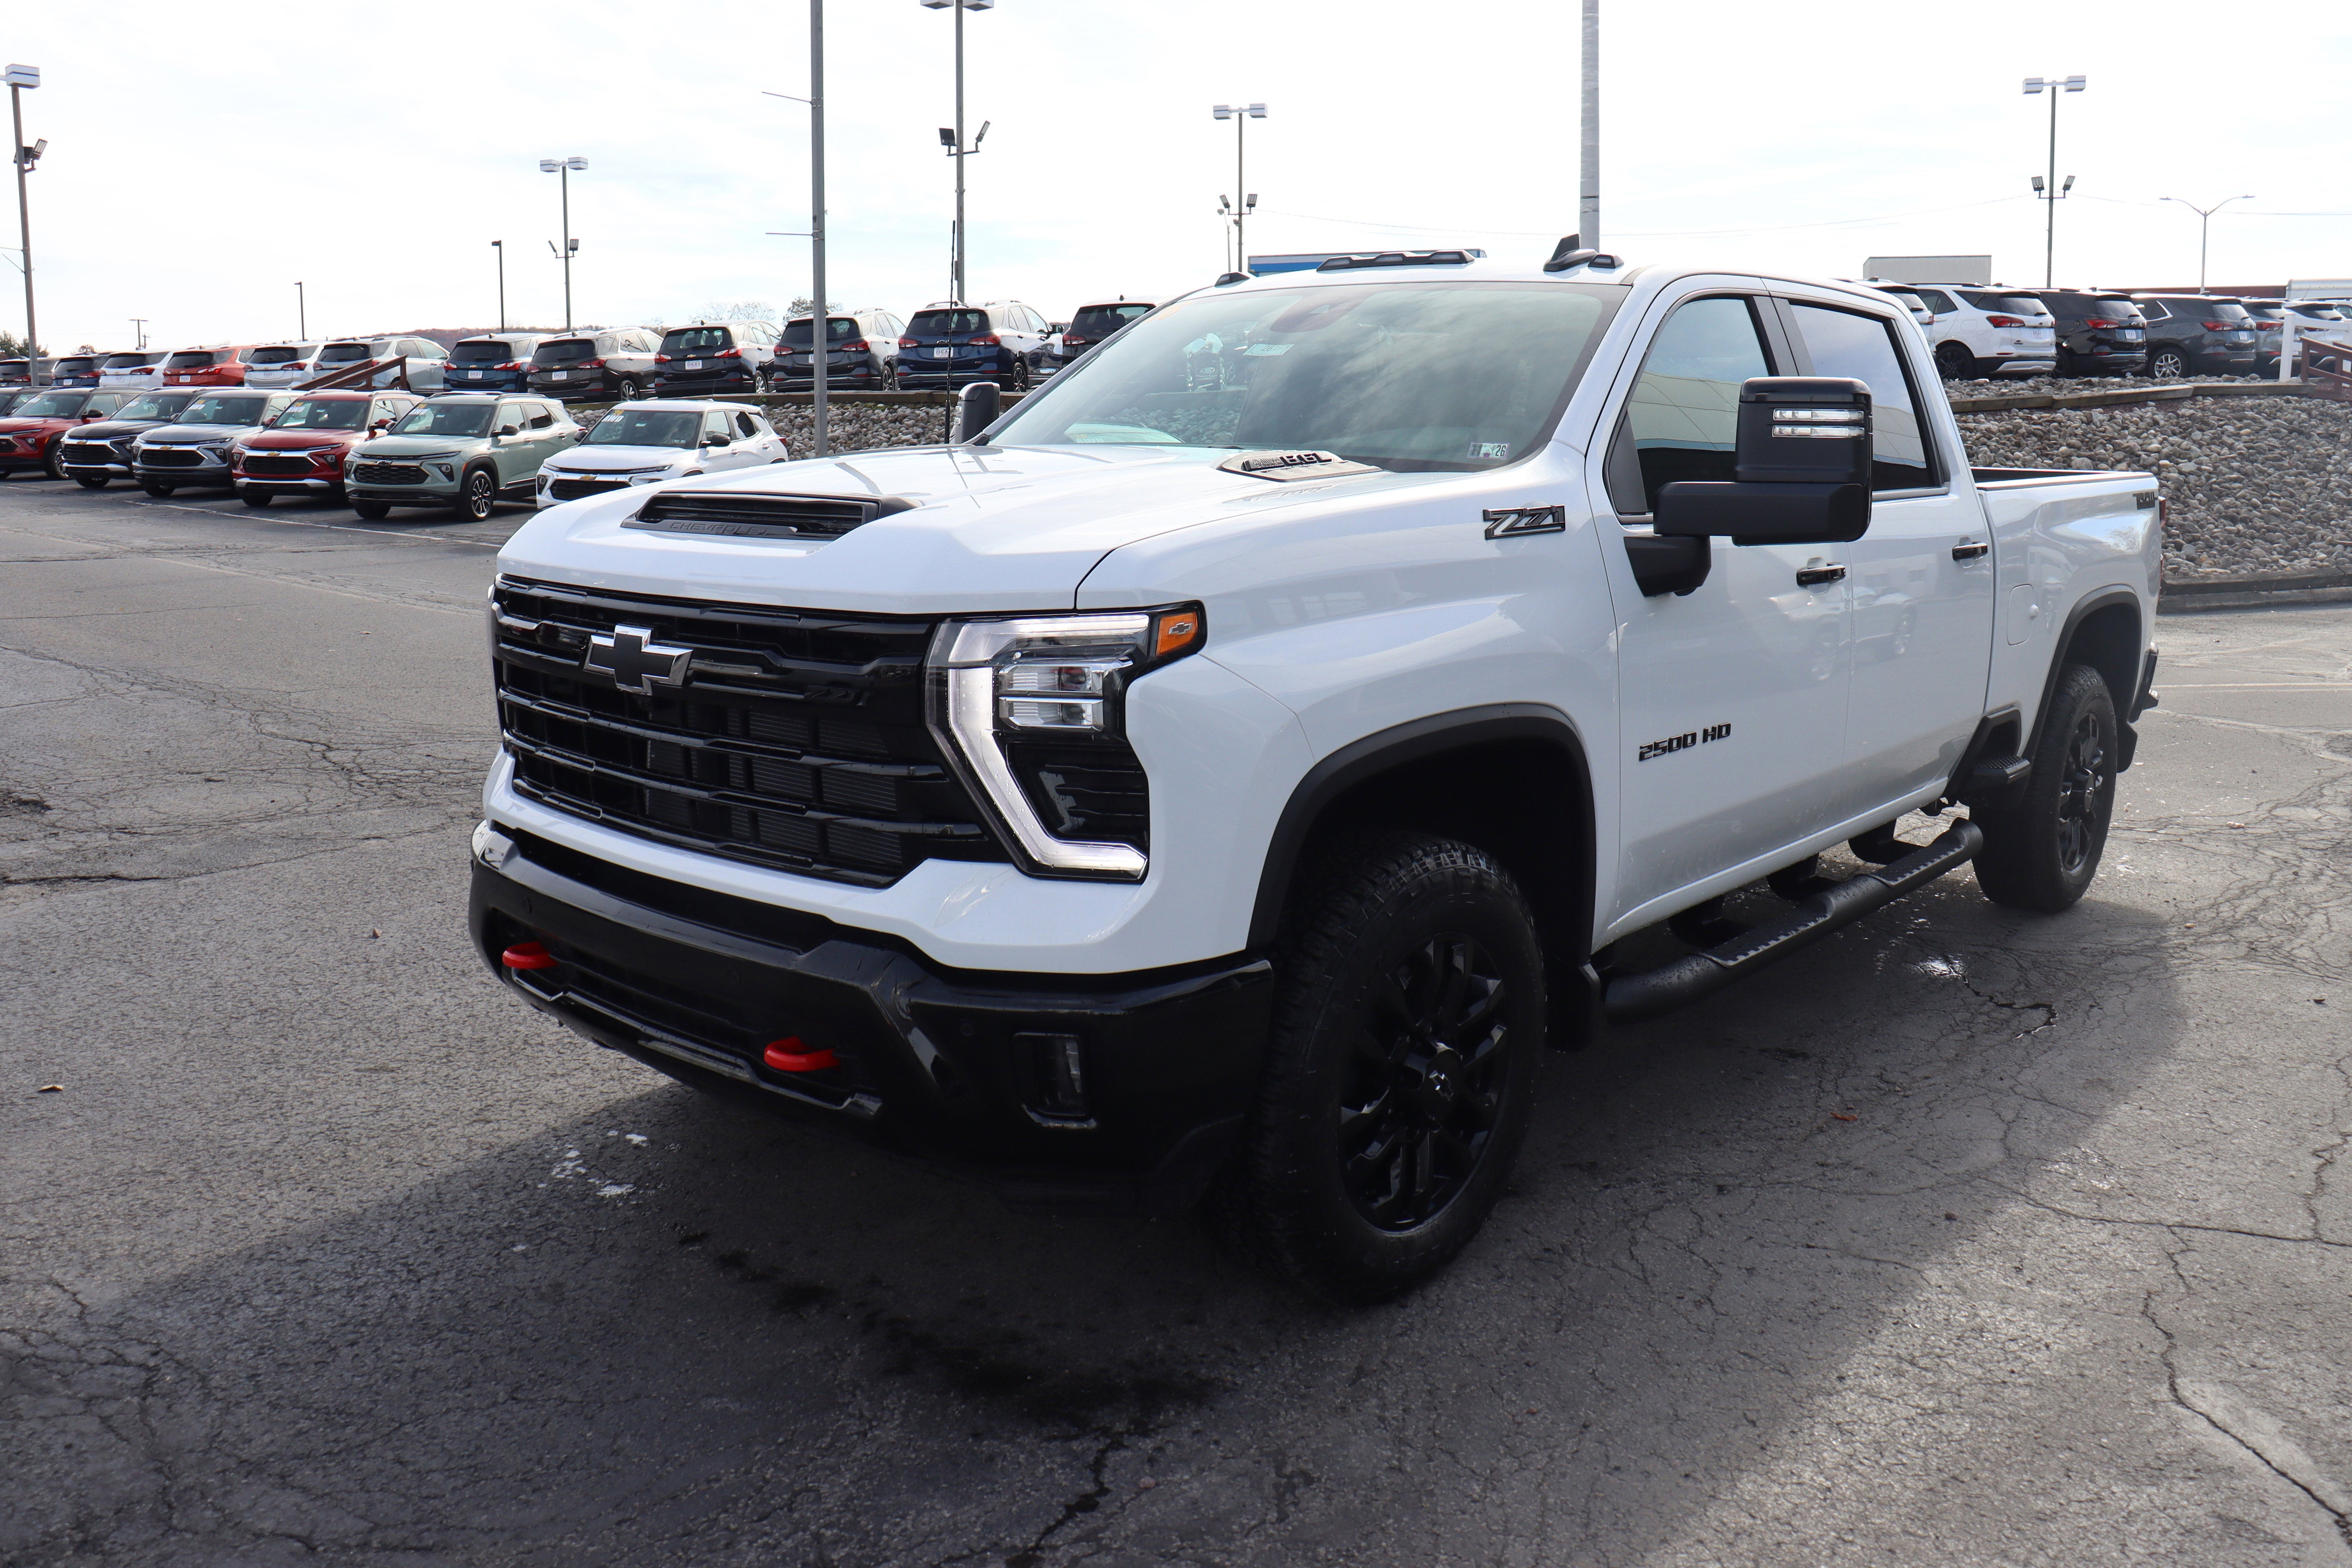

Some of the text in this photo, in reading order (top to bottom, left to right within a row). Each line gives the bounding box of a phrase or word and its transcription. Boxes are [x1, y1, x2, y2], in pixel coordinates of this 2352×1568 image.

[1495, 445, 1506, 457] 26
[1483, 505, 1566, 540] Z71
[1639, 722, 1731, 761] 2500 HD
